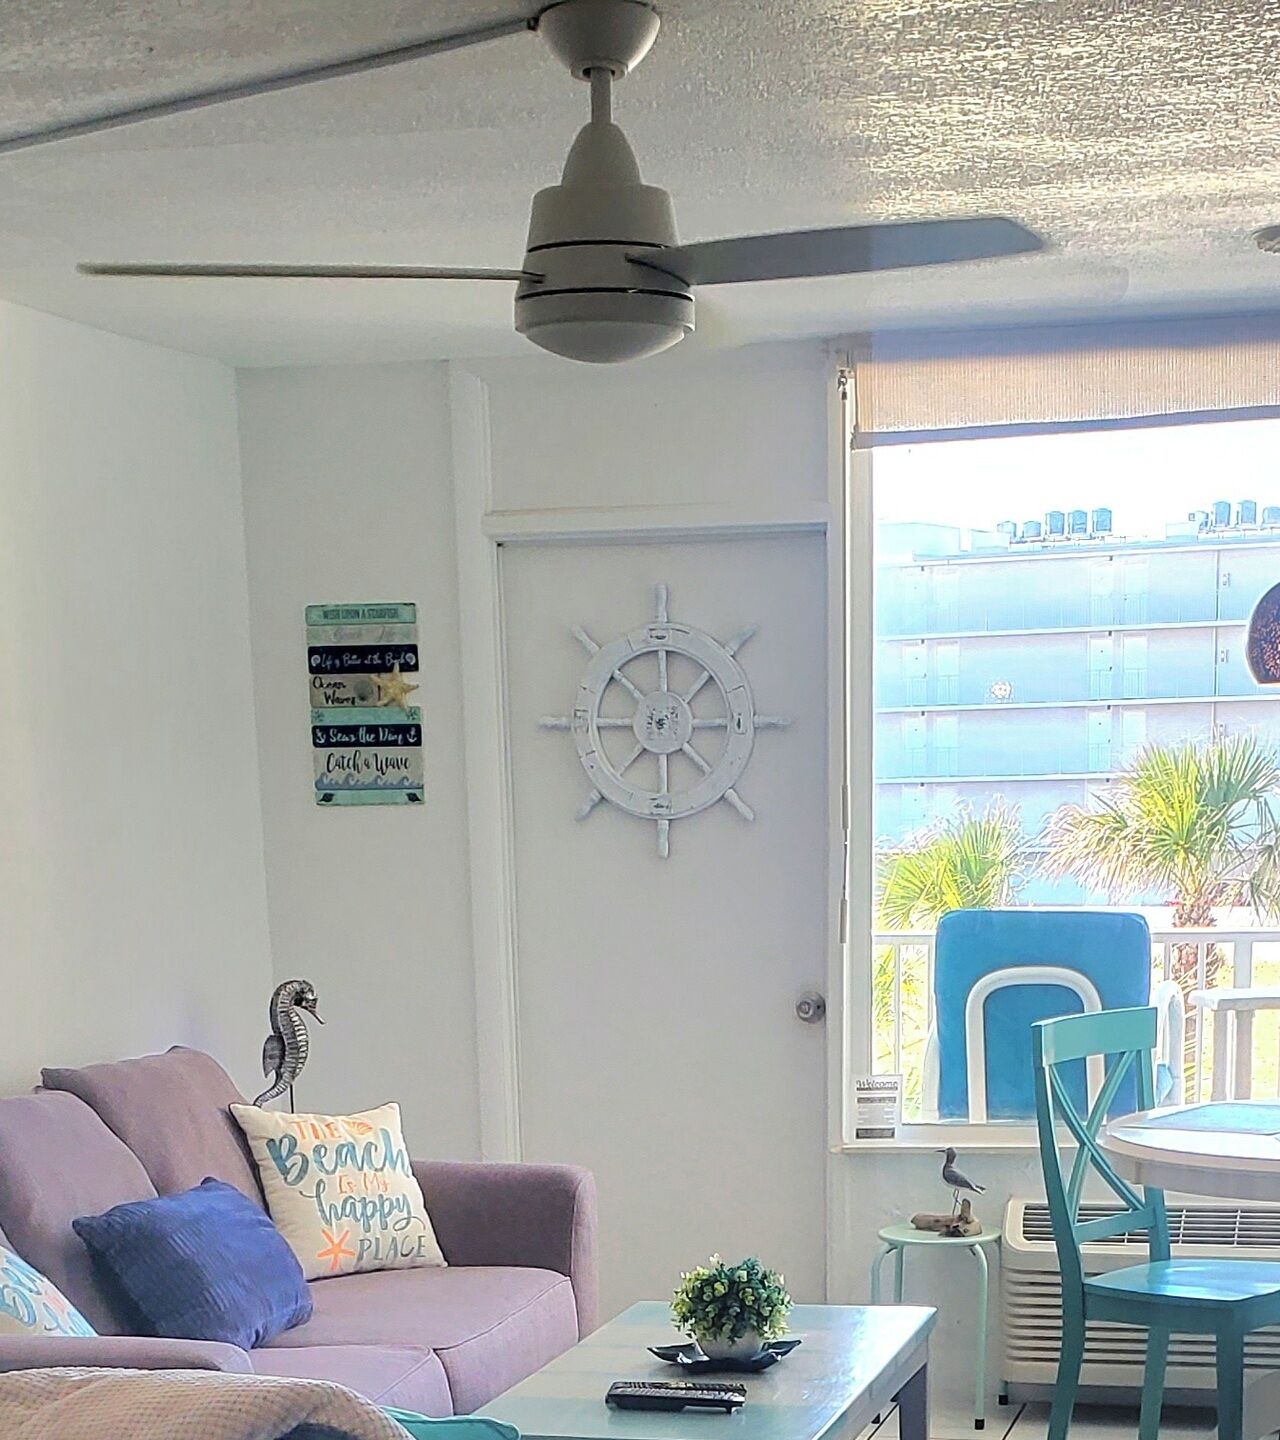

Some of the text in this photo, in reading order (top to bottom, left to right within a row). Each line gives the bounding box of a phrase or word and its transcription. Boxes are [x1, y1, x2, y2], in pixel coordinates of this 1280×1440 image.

[327, 749, 410, 776] Catch a Wave
[266, 1128, 411, 1186] Beach
[299, 1178, 426, 1233] happy
[356, 1234, 427, 1263] PLACE
